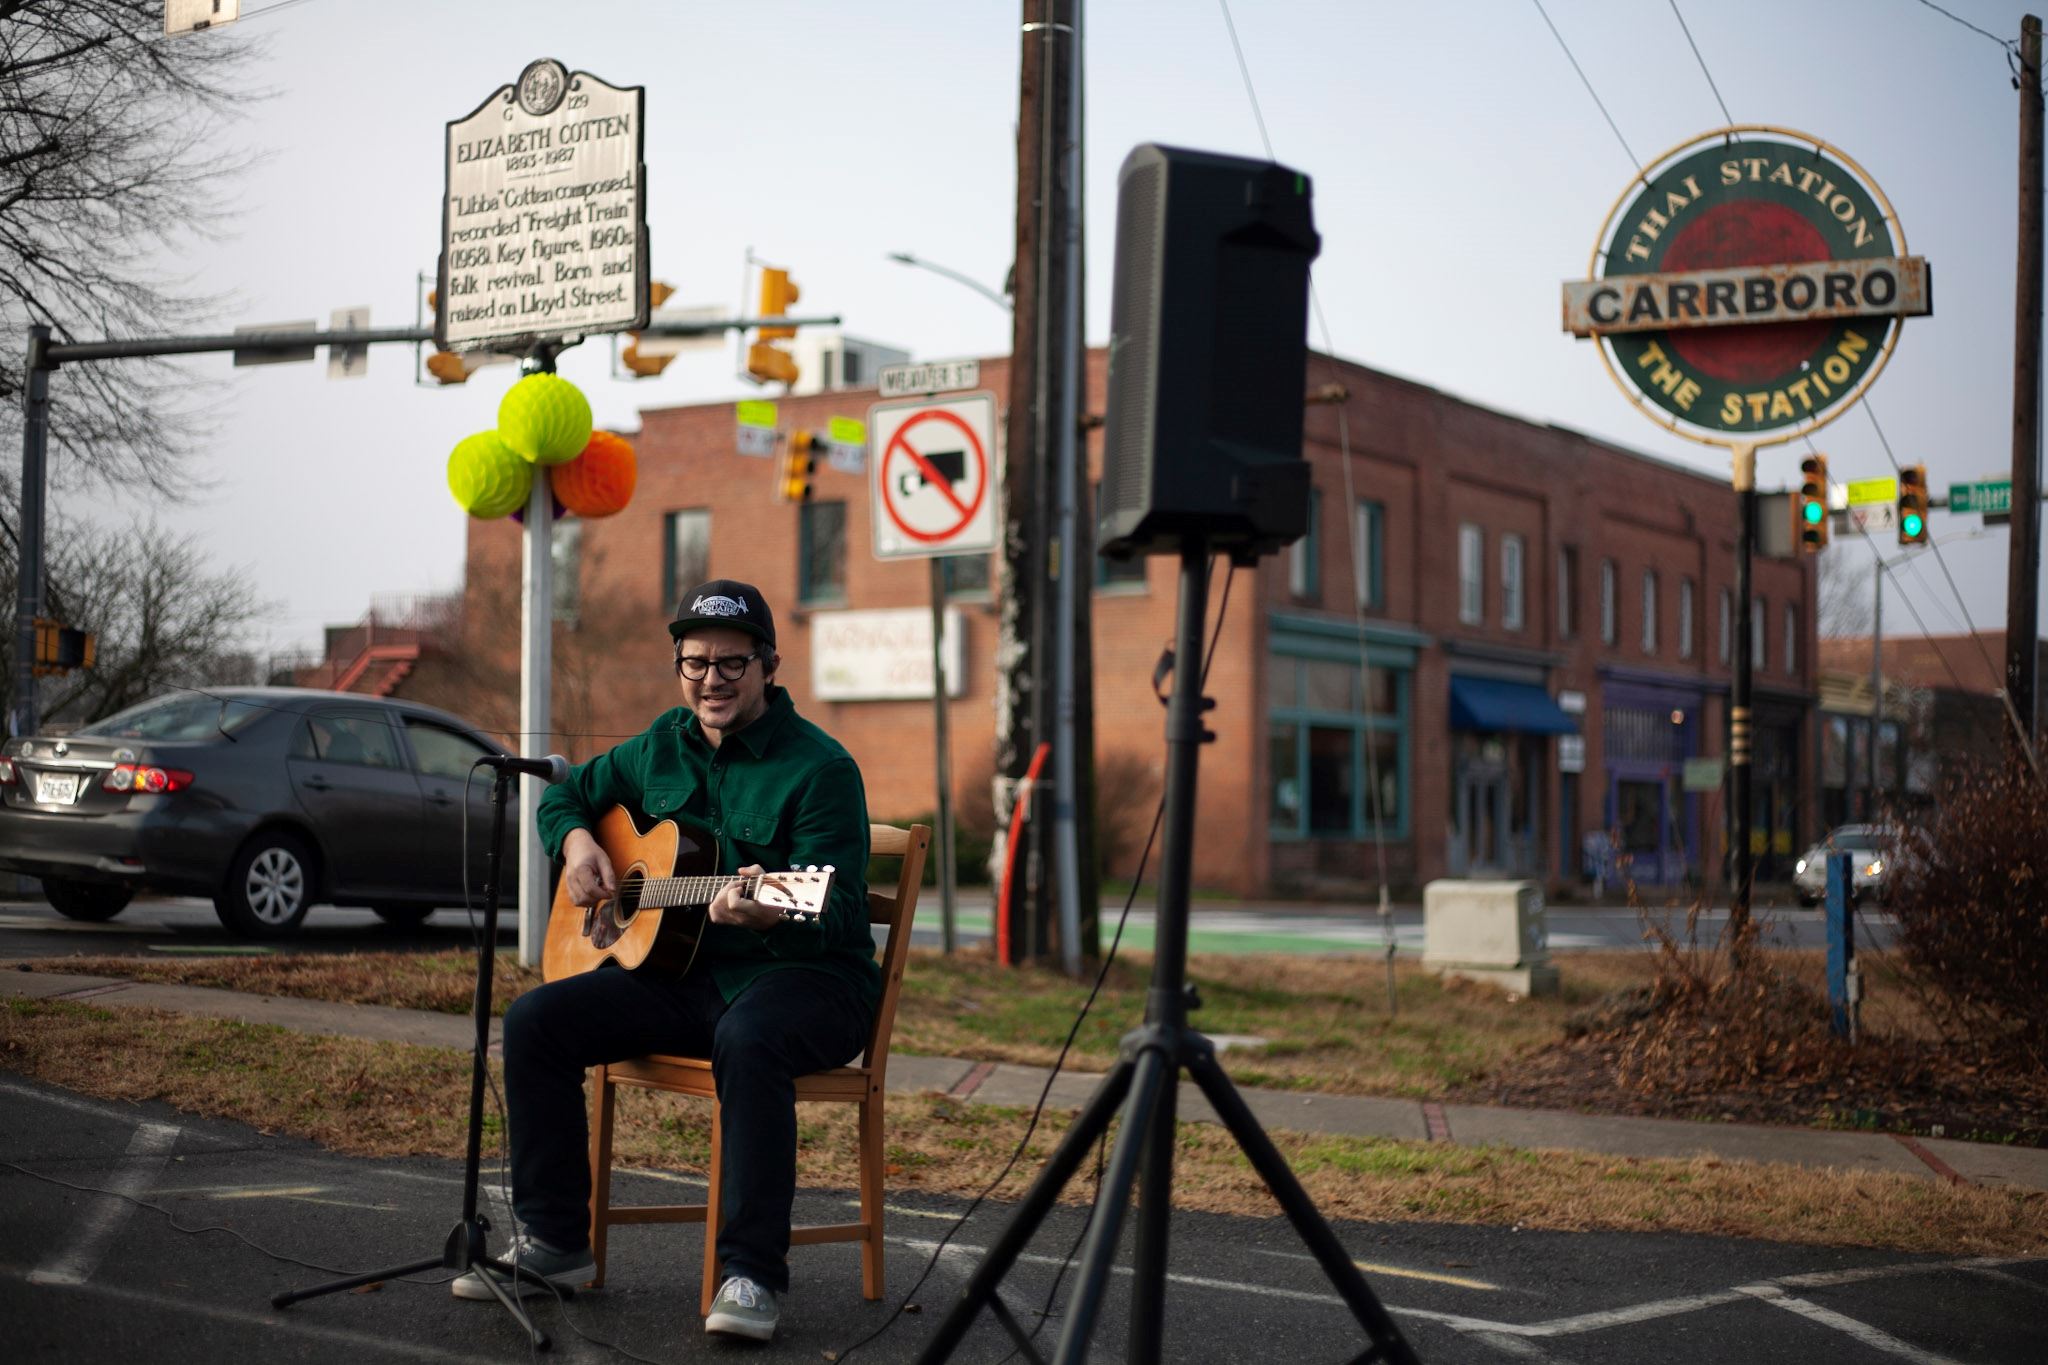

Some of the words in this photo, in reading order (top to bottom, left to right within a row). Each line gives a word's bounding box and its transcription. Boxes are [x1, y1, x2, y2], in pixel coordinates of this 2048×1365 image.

[456, 127, 552, 163] ELIZABETH
[559, 114, 630, 144] COTTEN
[506, 148, 576, 172] 1893-1987
[504, 185, 553, 208] Cotten
[1626, 176, 1704, 264] THAI
[1720, 157, 1875, 250] STATION
[450, 217, 520, 244] recorded
[497, 242, 526, 265] Key
[590, 226, 633, 250] 1960s
[450, 275, 478, 296] folk
[555, 261, 592, 282] Born
[602, 253, 632, 276] and
[449, 299, 495, 323] raised
[499, 303, 517, 316] on
[521, 290, 566, 316] Lloyd
[1588, 269, 1897, 325] CARRBORO
[1638, 341, 1702, 410] THE
[1720, 330, 1870, 425] STATION
